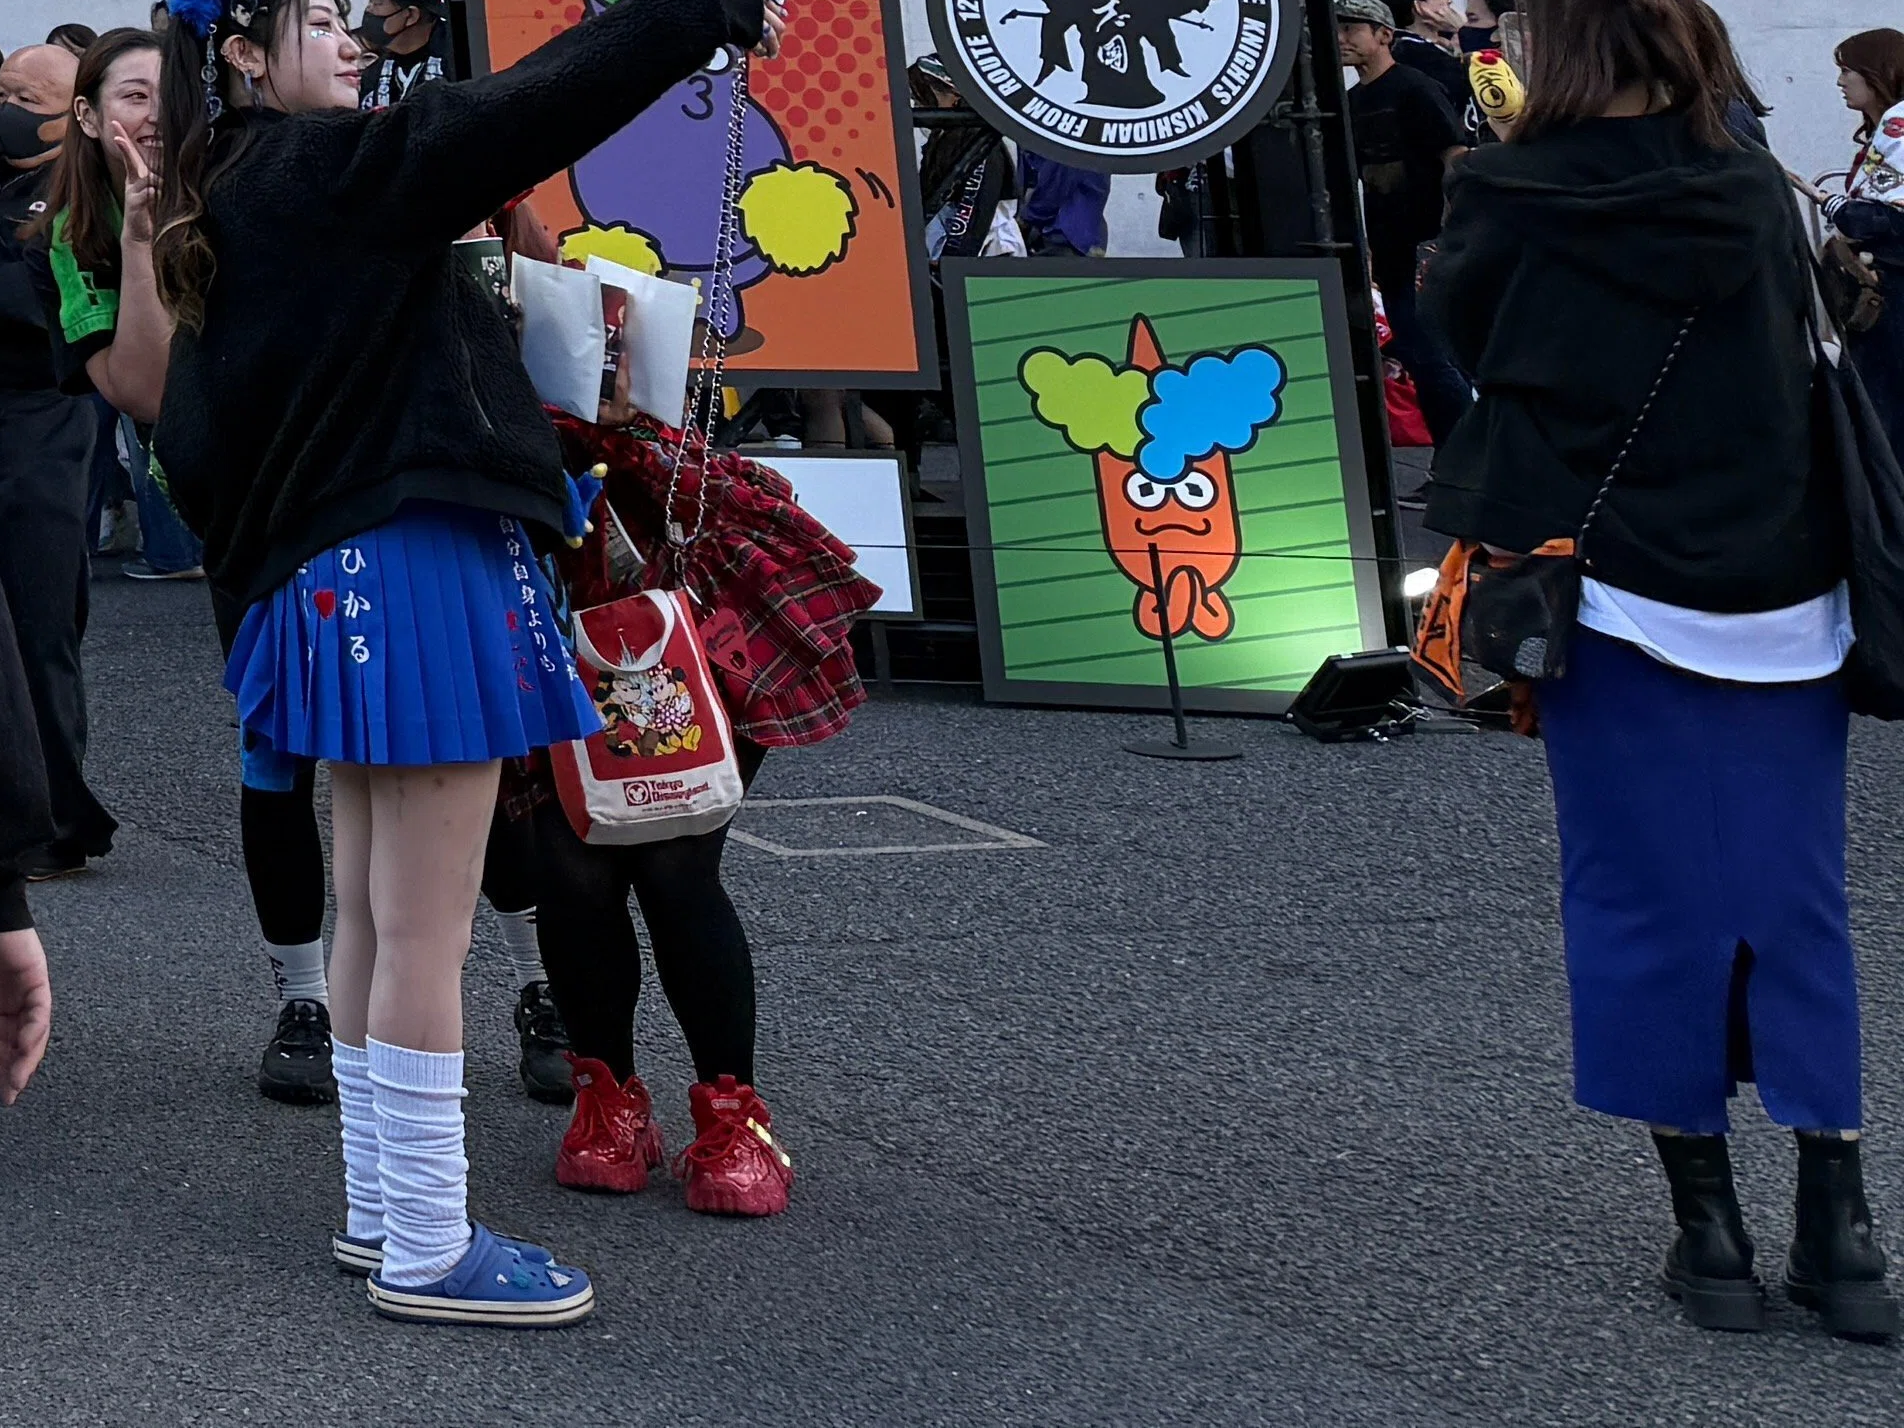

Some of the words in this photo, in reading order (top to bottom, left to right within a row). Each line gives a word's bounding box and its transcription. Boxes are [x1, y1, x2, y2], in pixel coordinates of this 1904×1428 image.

[965, 33, 1022, 97] ROUTE
[1210, 19, 1267, 107] KNIGHTS
[1021, 93, 1088, 138] FROM
[1101, 99, 1209, 144] KISHIDAN
[340, 548, 371, 664] ひかる
